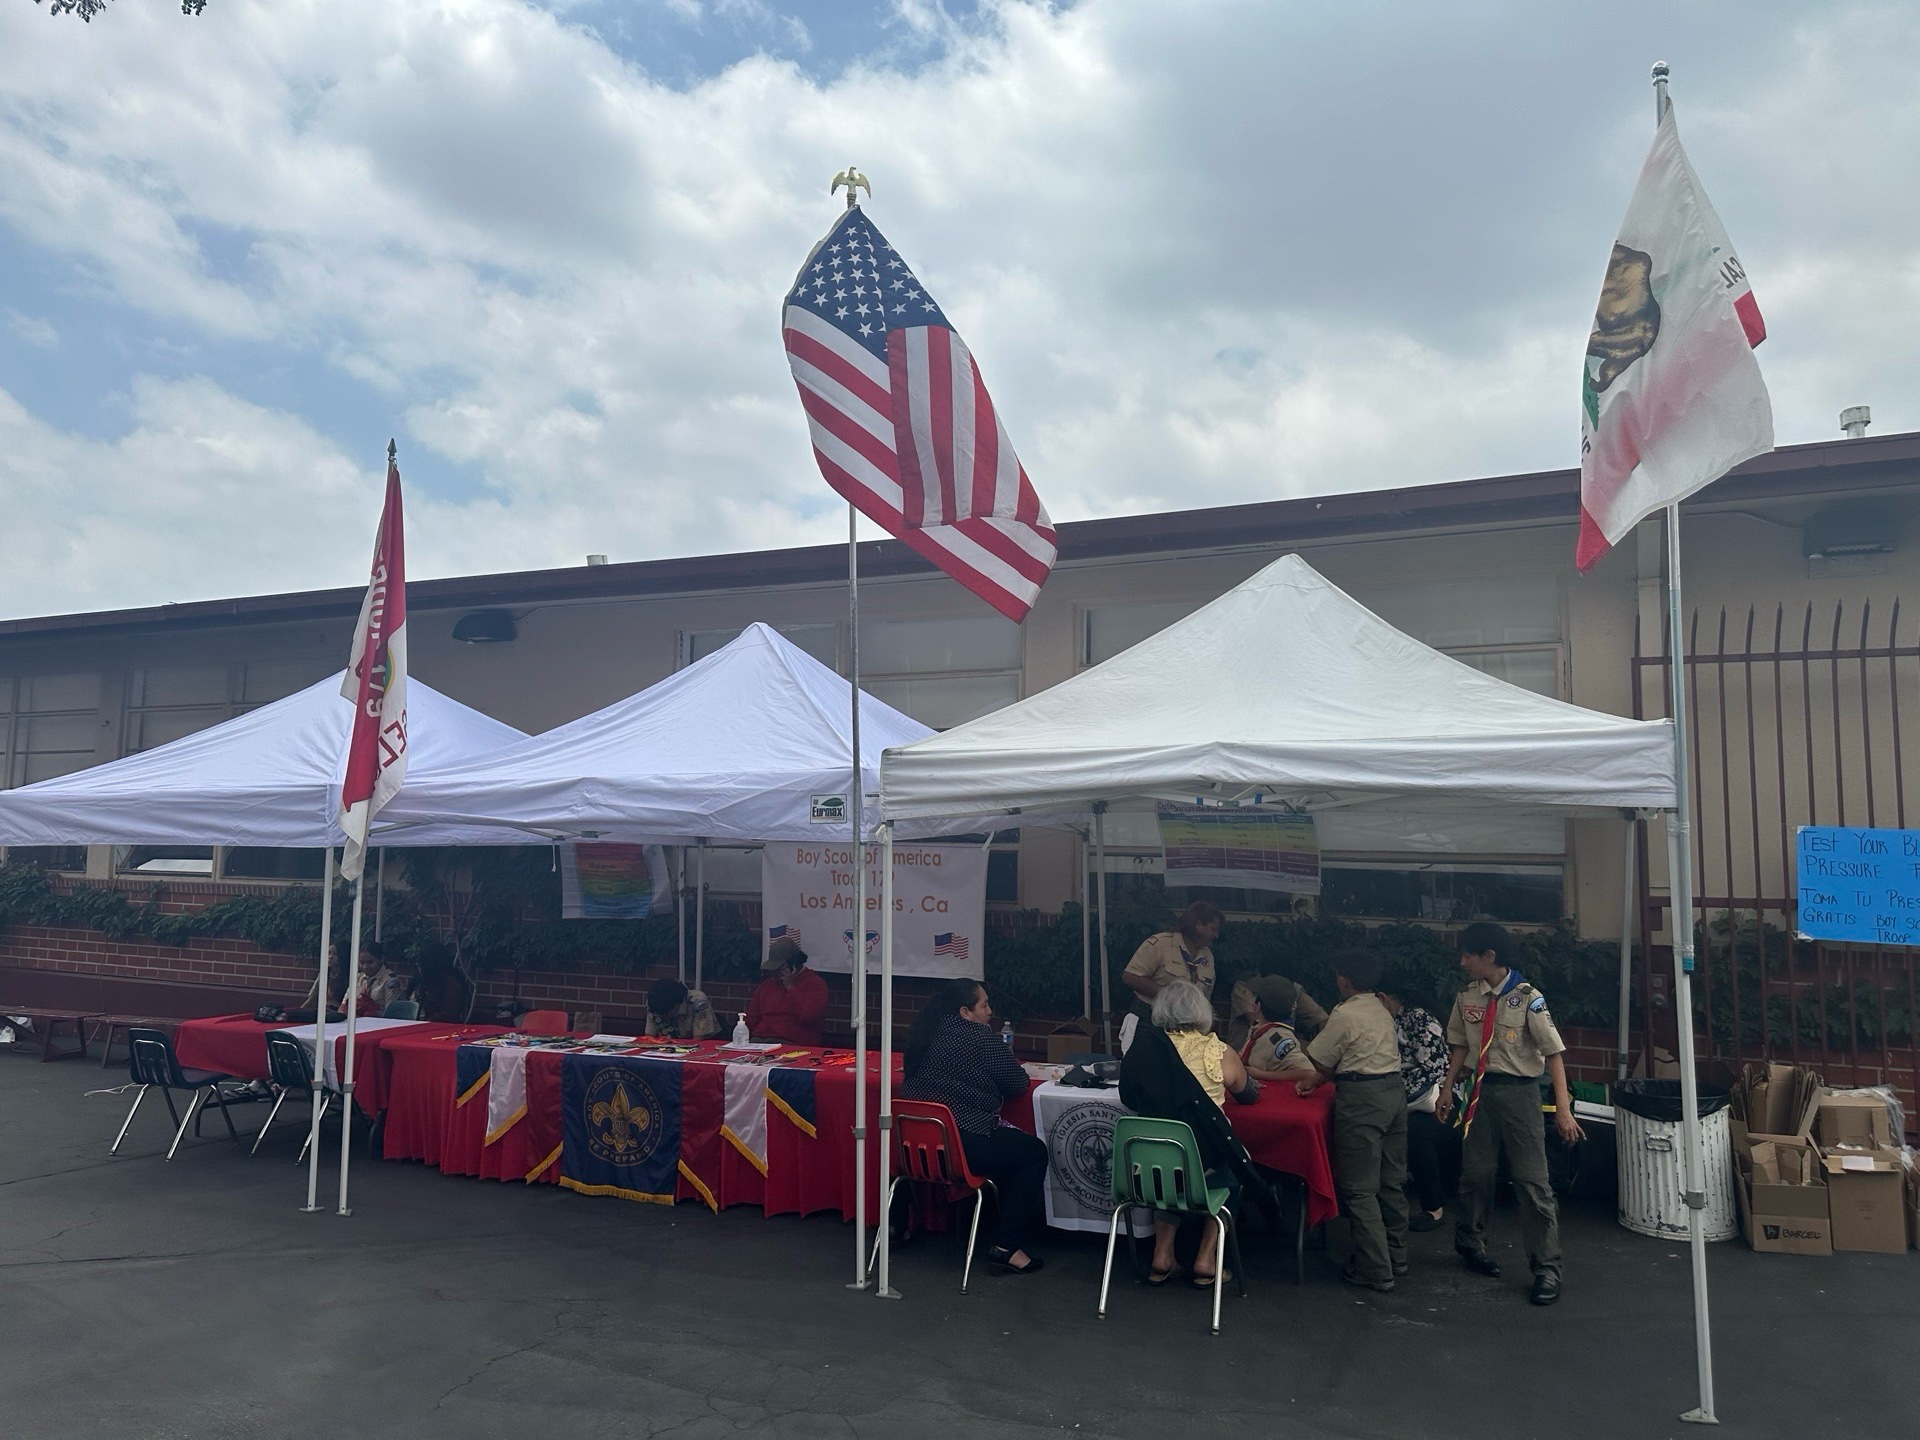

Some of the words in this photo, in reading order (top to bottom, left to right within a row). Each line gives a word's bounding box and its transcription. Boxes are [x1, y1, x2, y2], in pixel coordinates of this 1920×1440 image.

[812, 806, 842, 817] Eurmax
[1853, 832, 1888, 855] YOUR
[796, 848, 820, 868] Boy
[824, 848, 856, 864] Scou
[890, 849, 942, 867] merica
[1804, 855, 1885, 878] PRESSURE
[831, 870, 856, 886] Tro
[800, 893, 827, 909] Los
[833, 893, 904, 913] Anels
[921, 895, 949, 913] Ca
[1800, 888, 1838, 905] TOMA
[1851, 890, 1872, 907] TU
[1803, 907, 1856, 925] GRATIS
[1876, 914, 1897, 929] BOY
[1870, 927, 1911, 943] TROOP
[638, 1083, 662, 1129] AMERICA
[1057, 1112, 1086, 1140] IGLESIA
[1089, 1109, 1118, 1121] SANT
[1061, 1167, 1074, 1185] BOY
